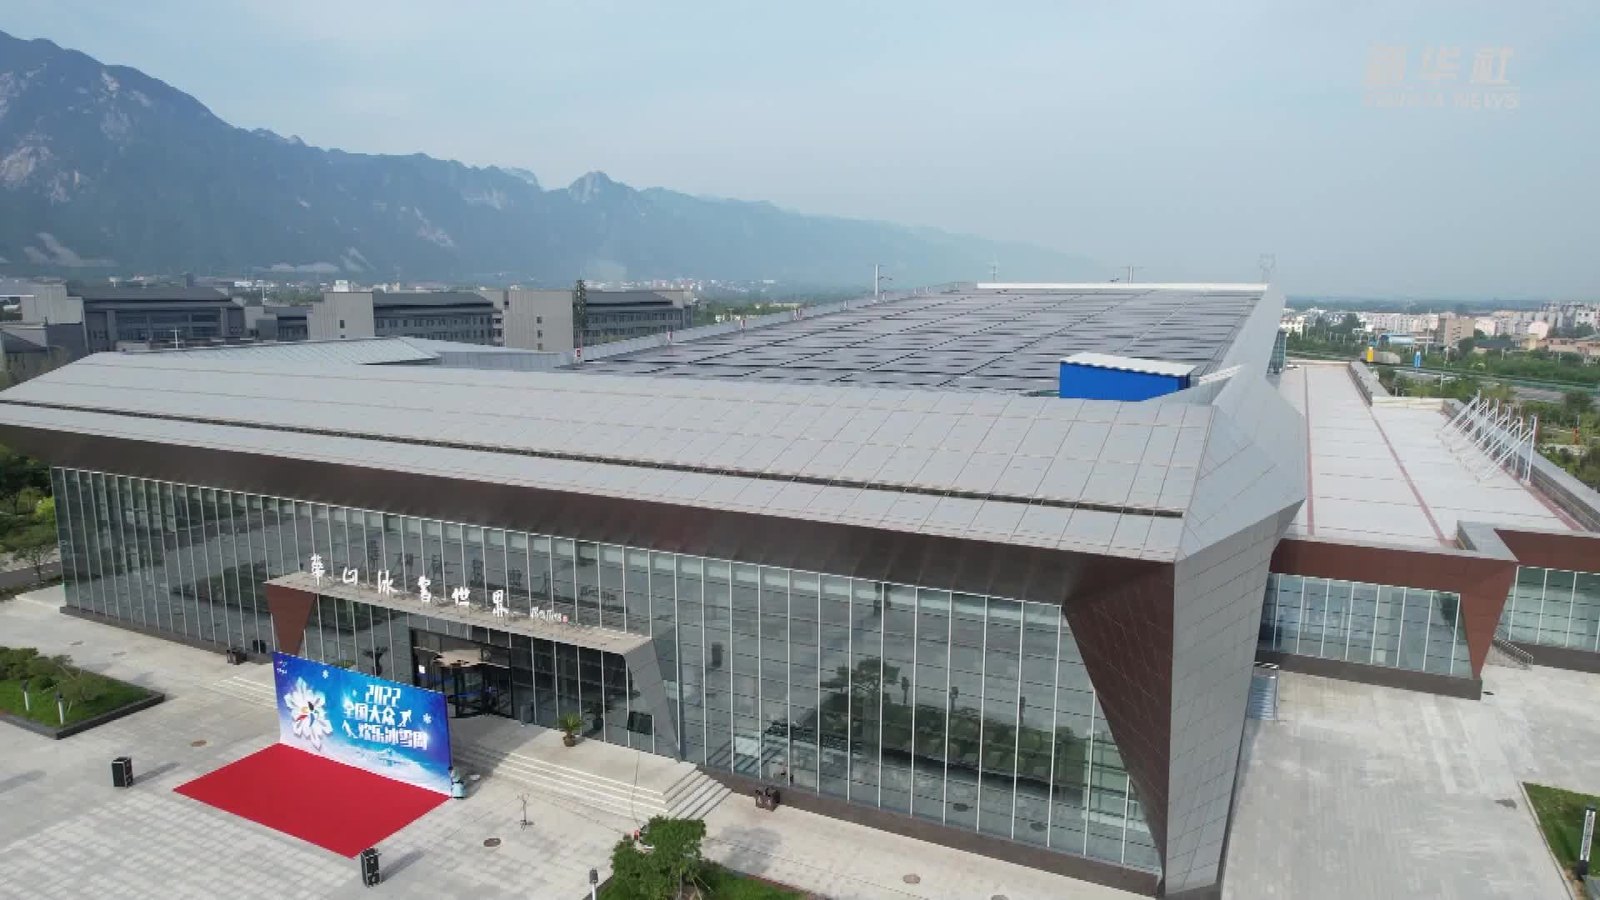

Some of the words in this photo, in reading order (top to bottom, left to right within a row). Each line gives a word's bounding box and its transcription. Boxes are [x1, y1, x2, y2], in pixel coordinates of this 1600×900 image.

[365, 684, 401, 707] 2022
[343, 701, 396, 726] 全国大众
